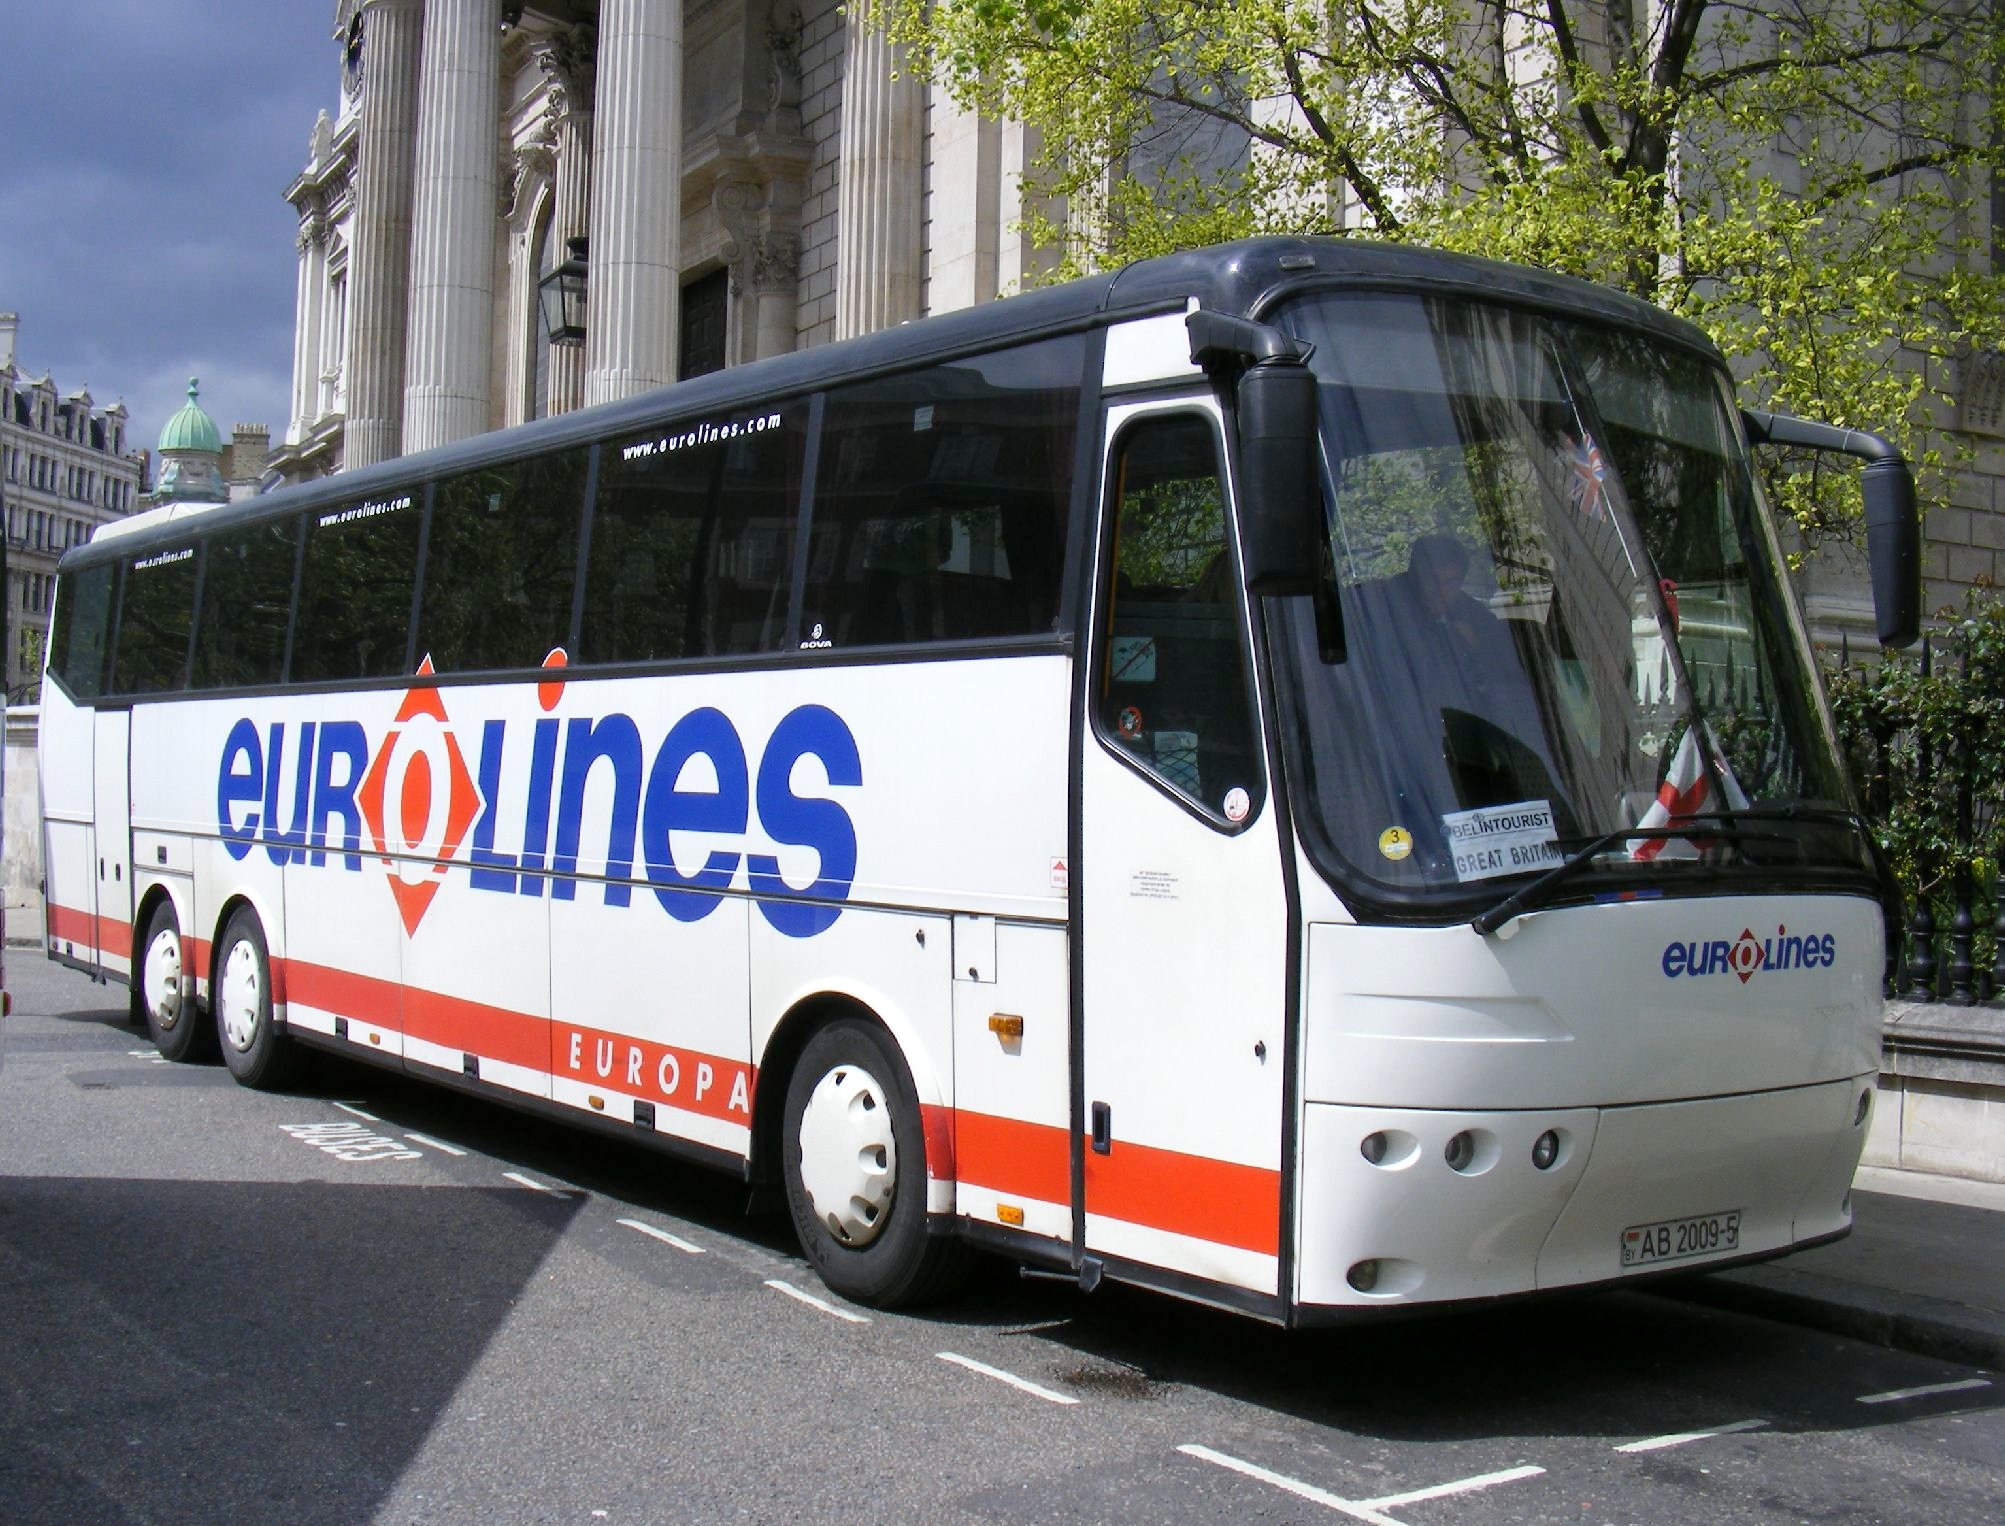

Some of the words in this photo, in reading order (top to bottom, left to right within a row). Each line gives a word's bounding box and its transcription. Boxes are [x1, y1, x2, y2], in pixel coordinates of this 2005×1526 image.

[623, 413, 781, 460] www.eurolines.com
[320, 497, 411, 527] www.eurolines.com
[800, 641, 832, 649] BOVA
[1390, 830, 1400, 843] 3
[1452, 813, 1549, 839] BELINTOURIST
[1456, 849, 1503, 873] GREAT
[1510, 843, 1561, 865] BRITAIN
[569, 1032, 749, 1114] EUROPA
[278, 1122, 423, 1161] BUSES
[1641, 1227, 1671, 1258] AB
[1677, 1215, 1739, 1254] 2009-5
